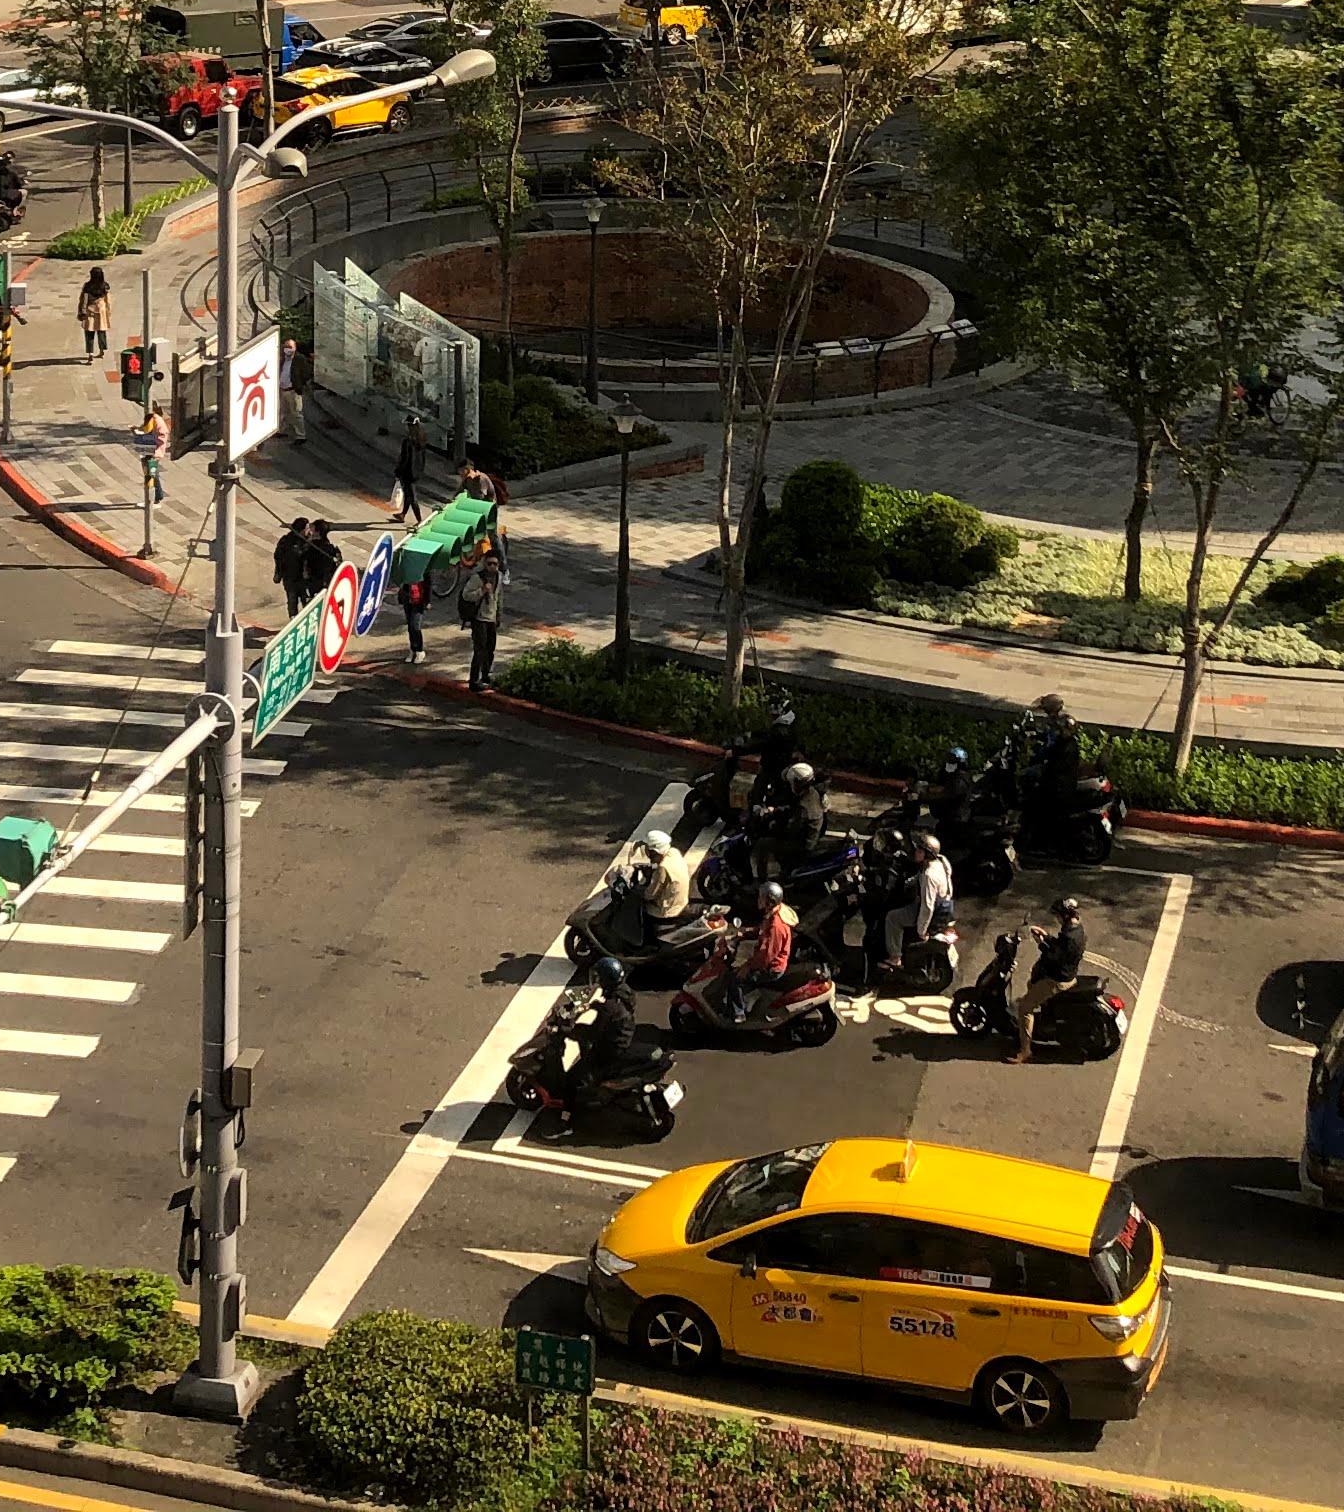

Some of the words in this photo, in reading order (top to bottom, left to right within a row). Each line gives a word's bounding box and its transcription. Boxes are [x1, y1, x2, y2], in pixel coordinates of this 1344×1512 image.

[270, 607, 320, 675] 南京西路
[890, 1316, 955, 1339] 55178
